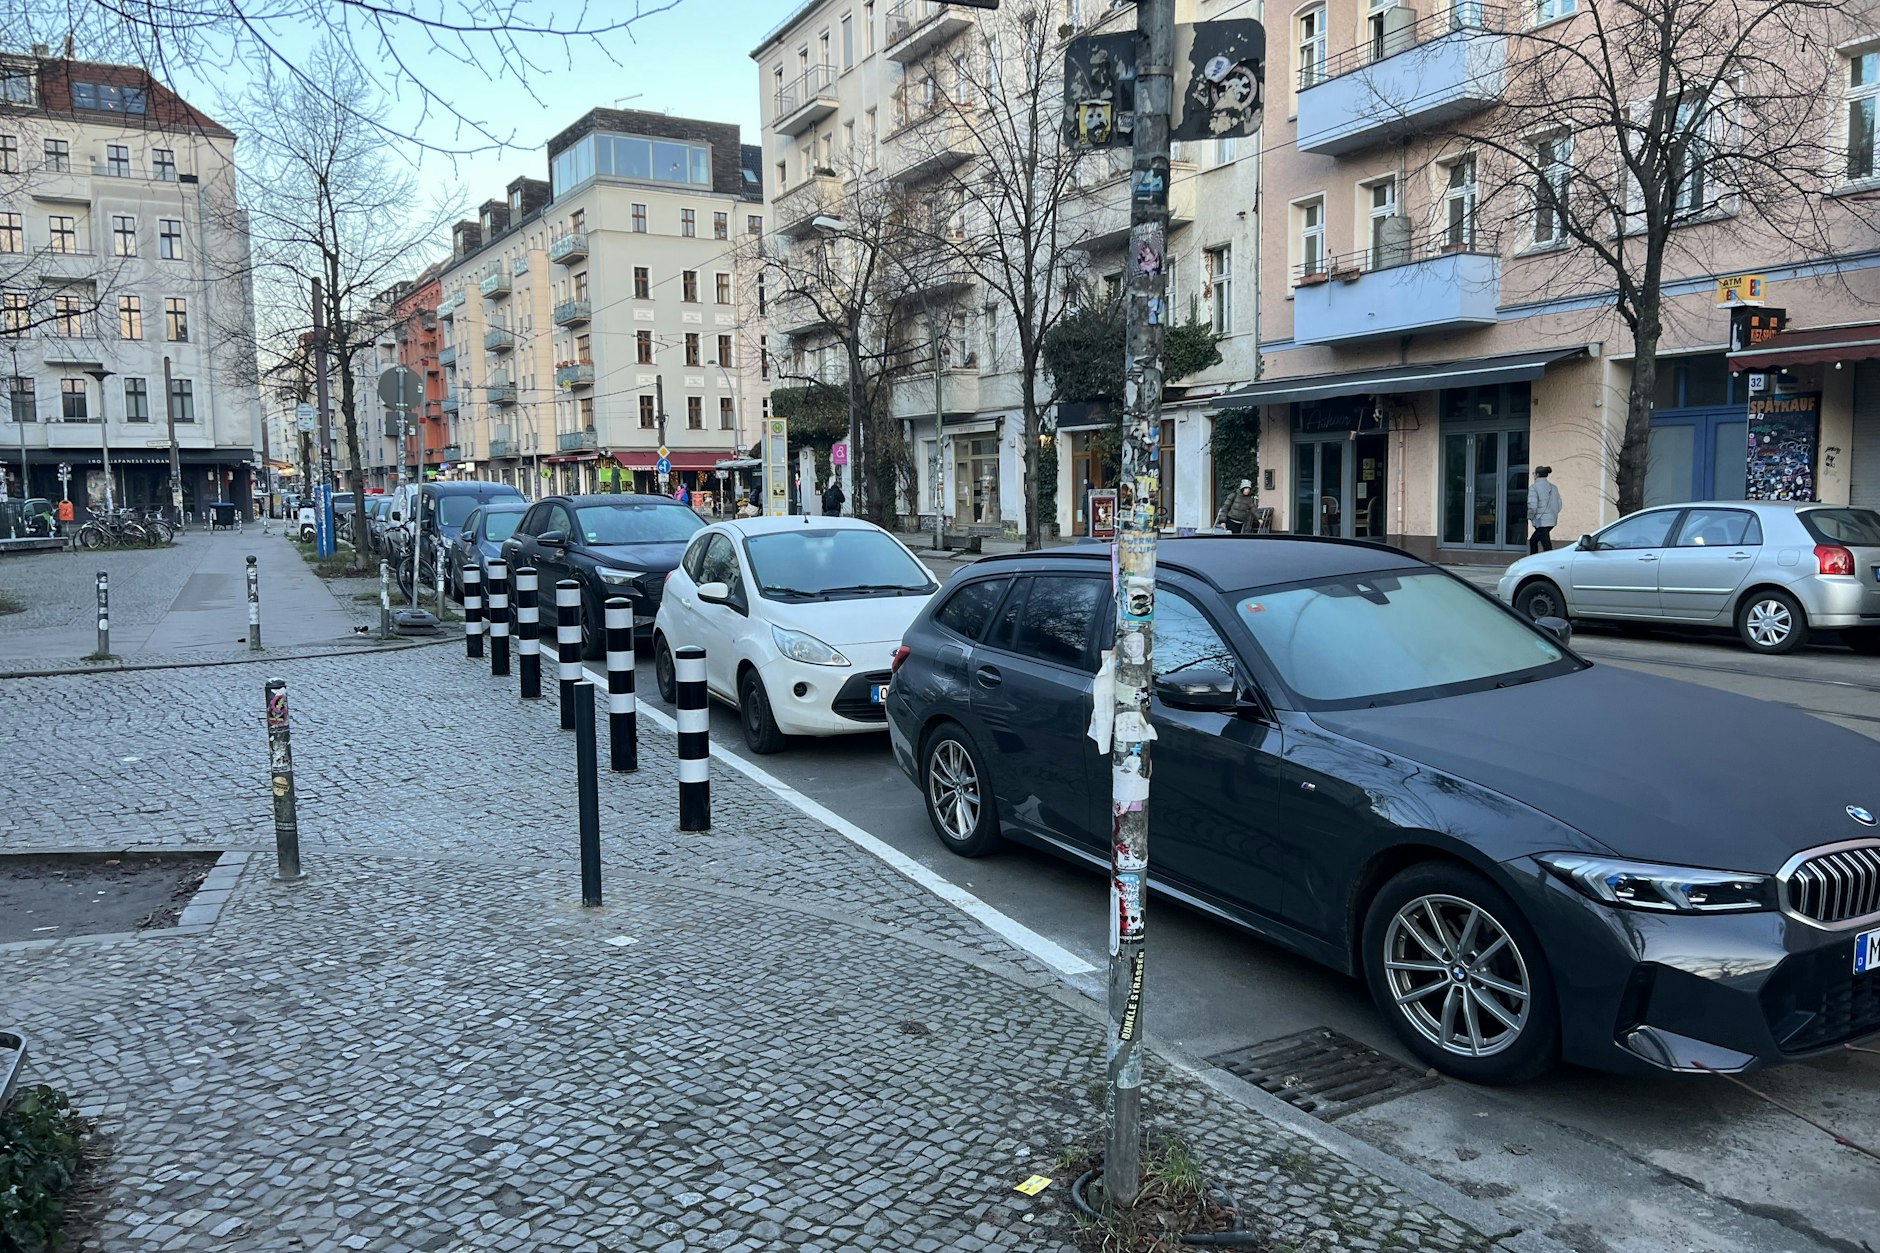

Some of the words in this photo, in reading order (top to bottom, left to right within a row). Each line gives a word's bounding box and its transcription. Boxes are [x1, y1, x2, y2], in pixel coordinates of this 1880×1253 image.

[1723, 278, 1742, 286] ATM
[1750, 377, 1762, 388] 32
[1750, 397, 1815, 414] SPÄTKAUF
[1857, 956, 1864, 966] D
[1122, 1003, 1137, 1040] DUNKLE
[1130, 951, 1145, 1001] STRASSEN
